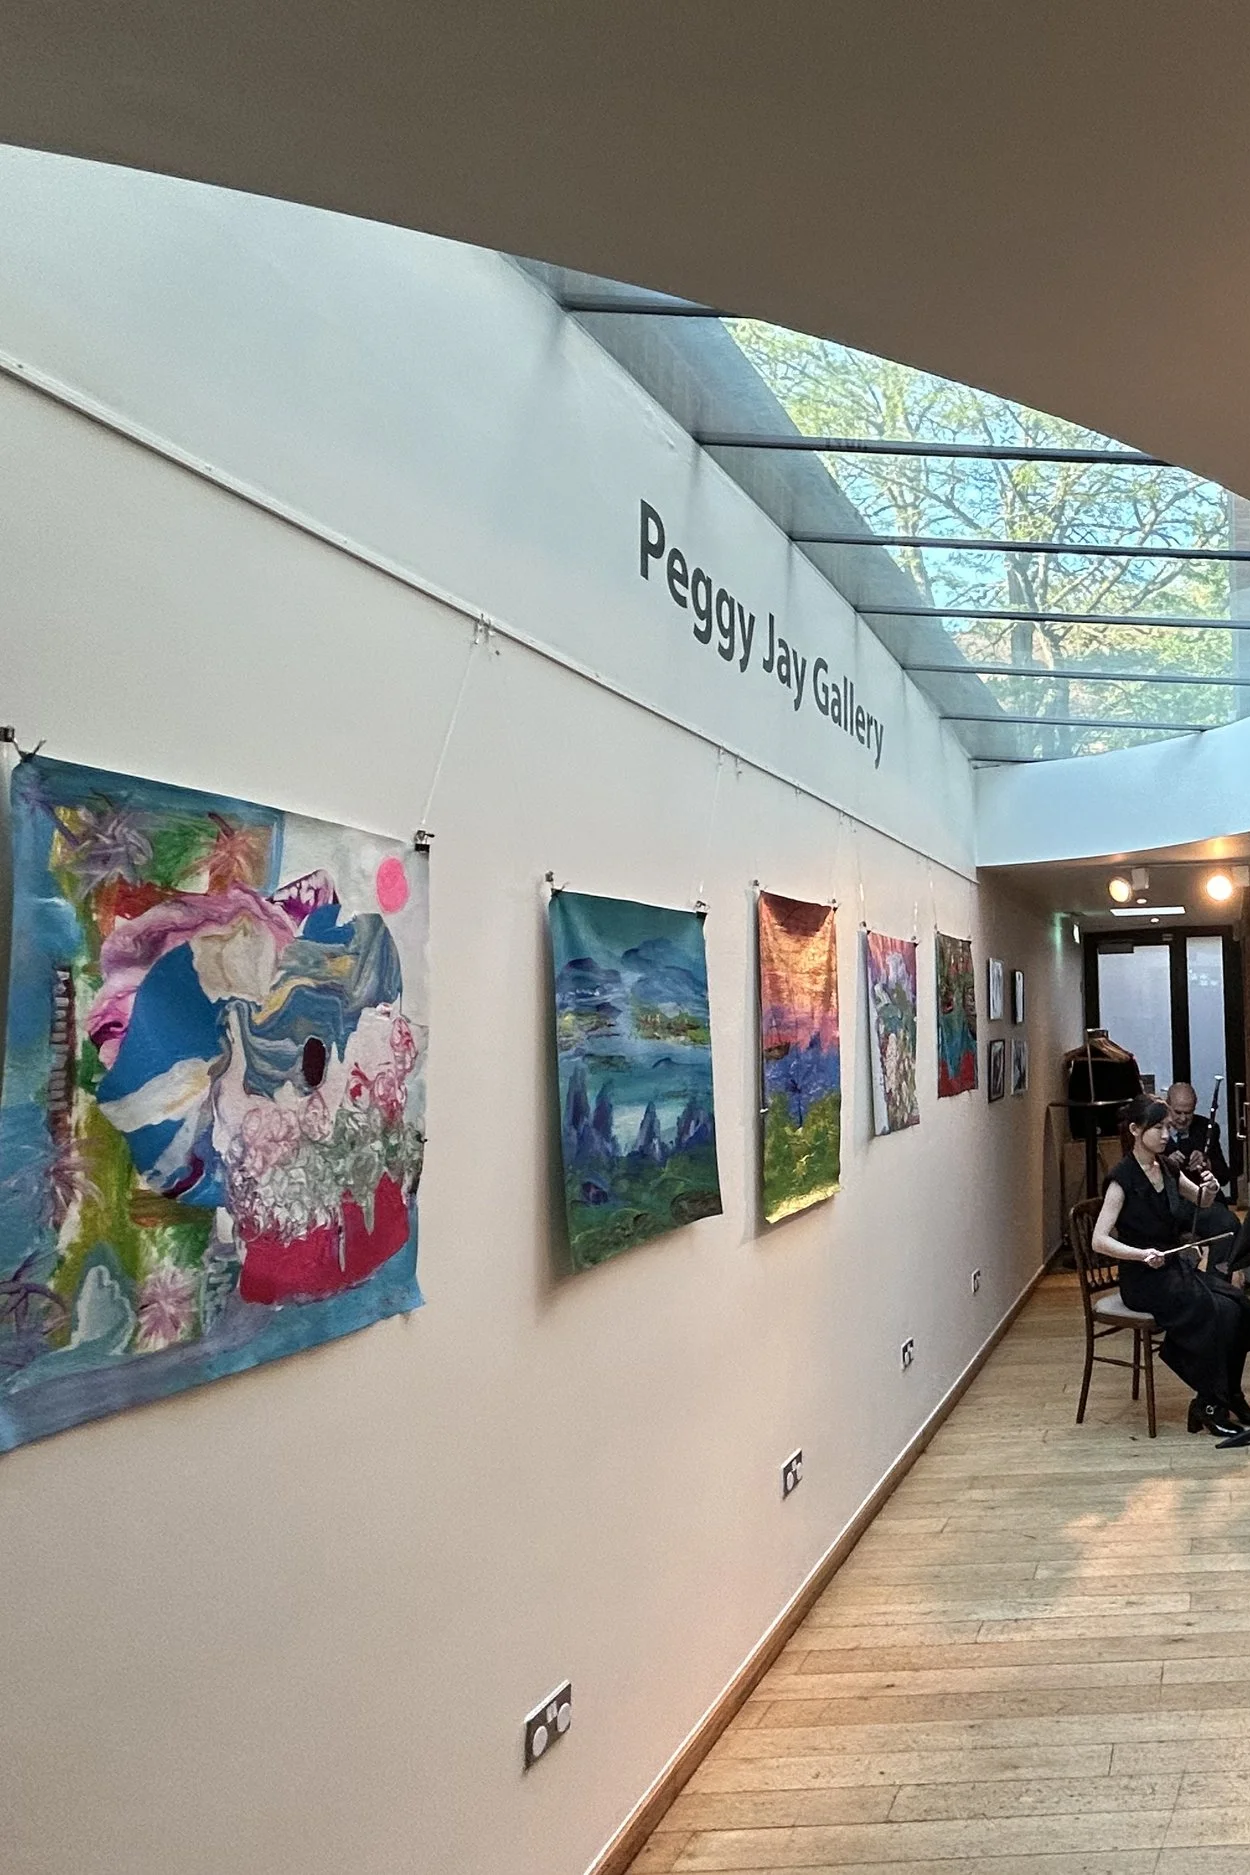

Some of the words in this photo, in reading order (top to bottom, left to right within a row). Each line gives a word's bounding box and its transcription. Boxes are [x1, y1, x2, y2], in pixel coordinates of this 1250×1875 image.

[639, 498, 756, 673] Peggy
[762, 612, 808, 712] Jay
[812, 656, 885, 770] Gallery
